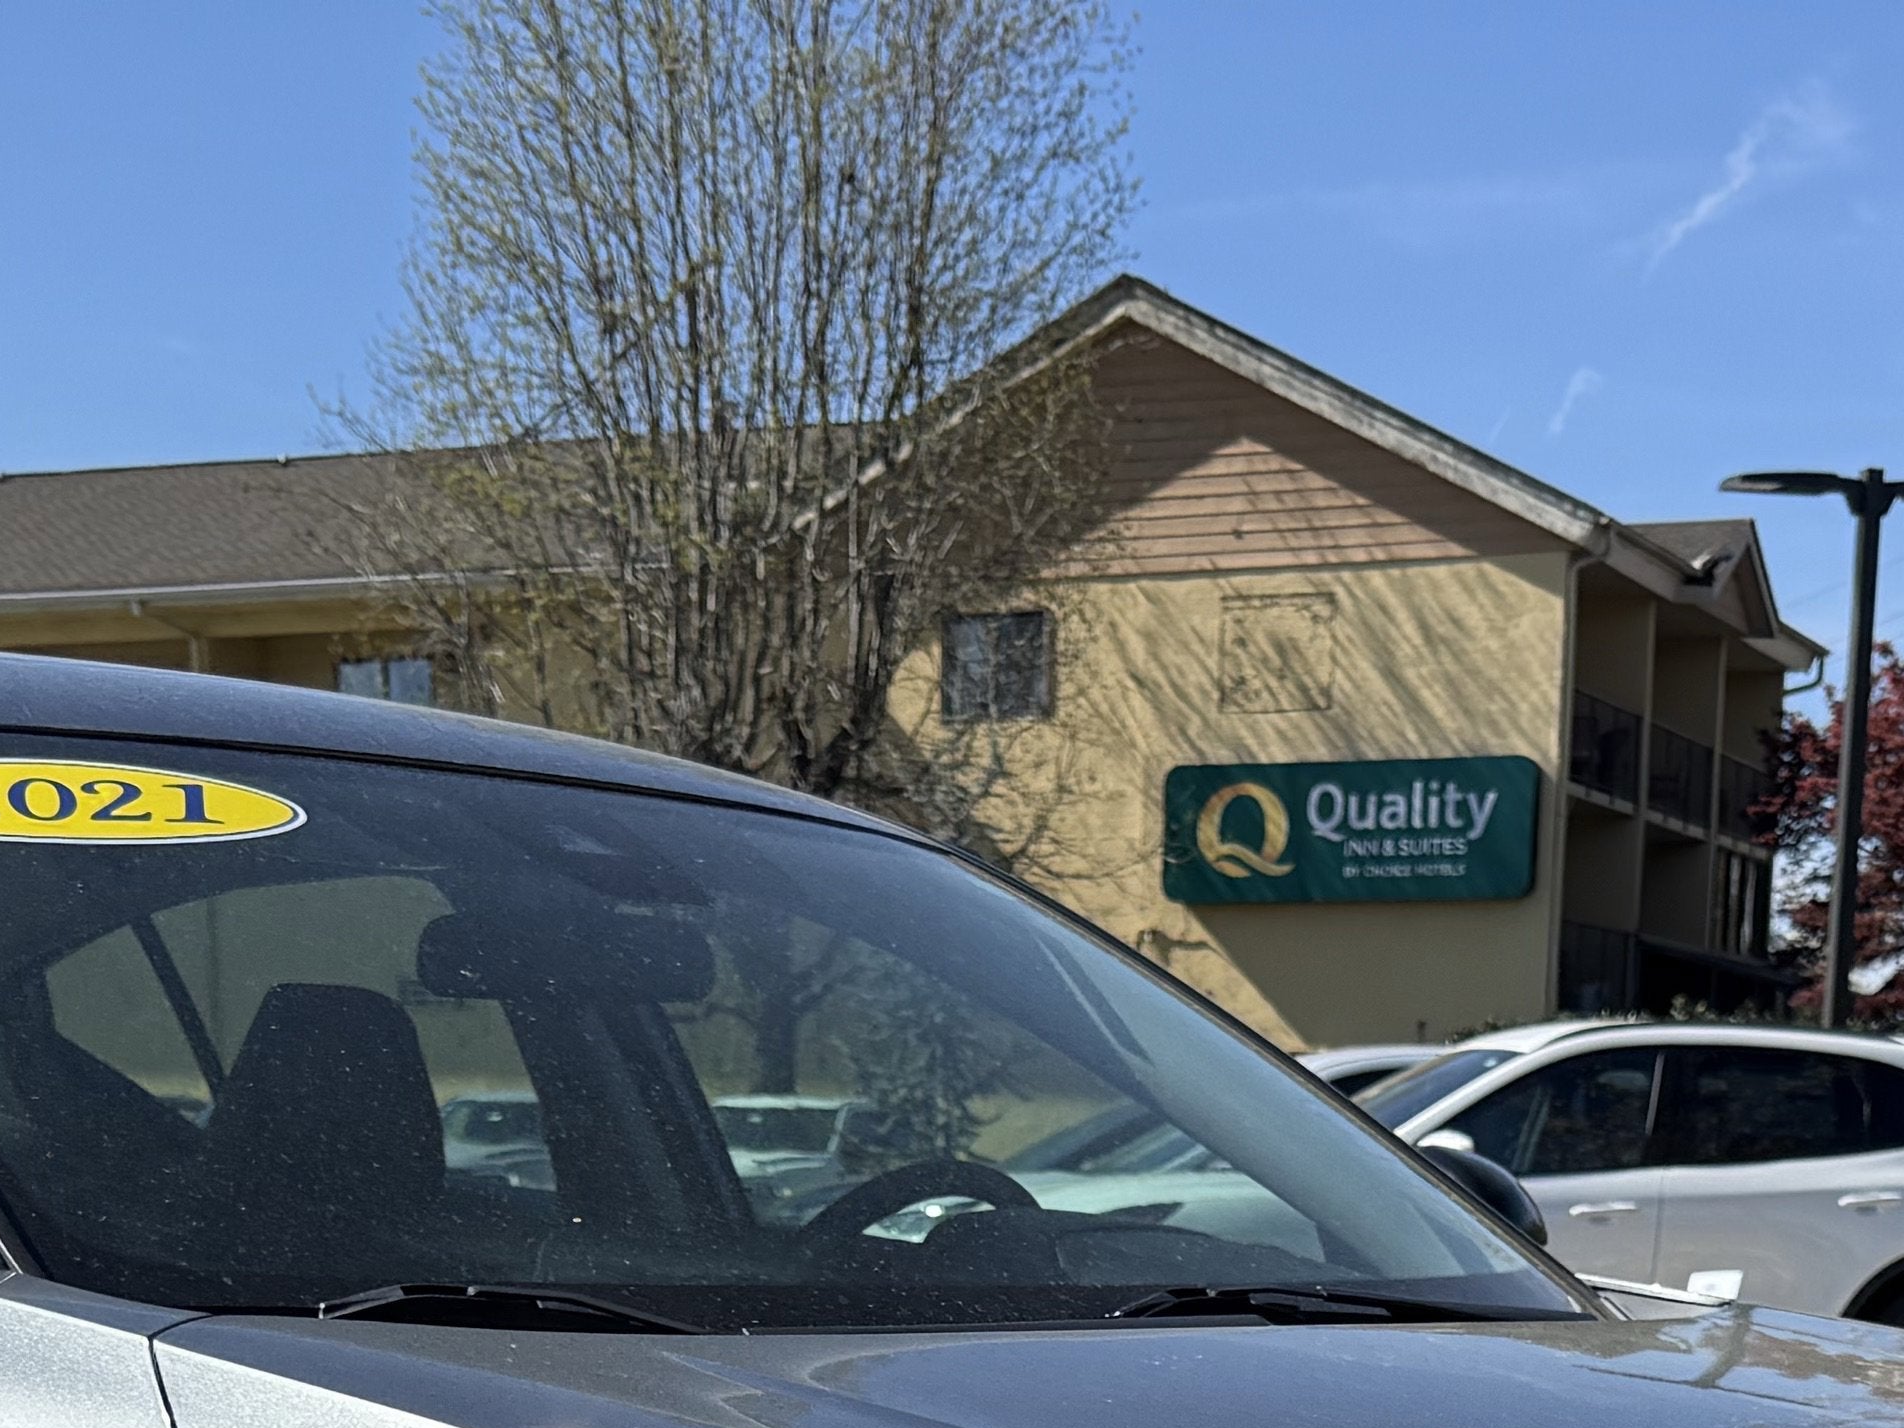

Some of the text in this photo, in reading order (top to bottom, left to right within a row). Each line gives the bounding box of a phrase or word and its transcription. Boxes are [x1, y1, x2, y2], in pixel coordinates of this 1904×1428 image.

[1196, 782, 1296, 878] Q
[1306, 779, 1499, 842] Quality
[1343, 836, 1468, 857] INN & SUITES
